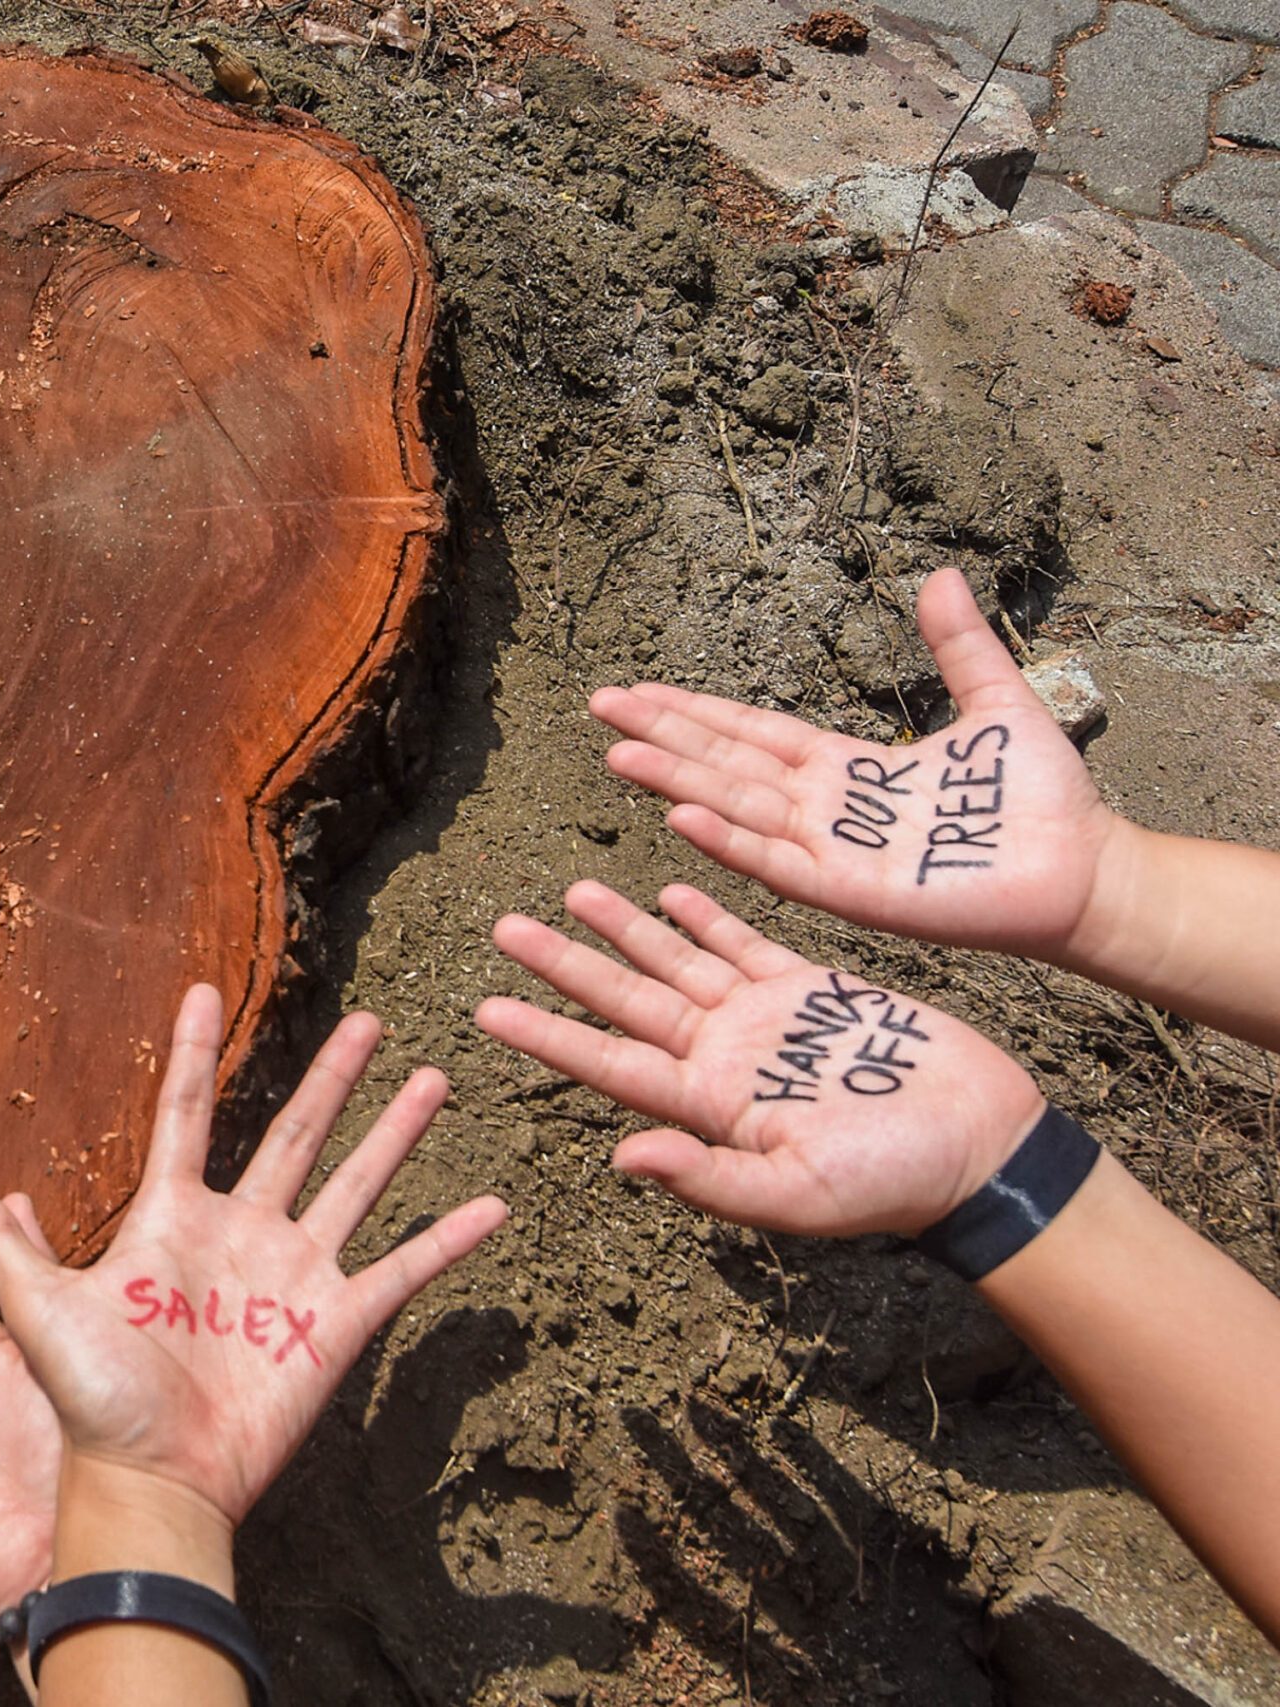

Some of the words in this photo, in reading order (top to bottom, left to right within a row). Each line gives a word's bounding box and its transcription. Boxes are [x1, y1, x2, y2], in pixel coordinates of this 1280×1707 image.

[832, 757, 920, 848] OUR
[916, 724, 1010, 885] TREES
[753, 972, 889, 1101] HANDS
[842, 1003, 930, 1095] OFF
[124, 1278, 323, 1367] SALEX
